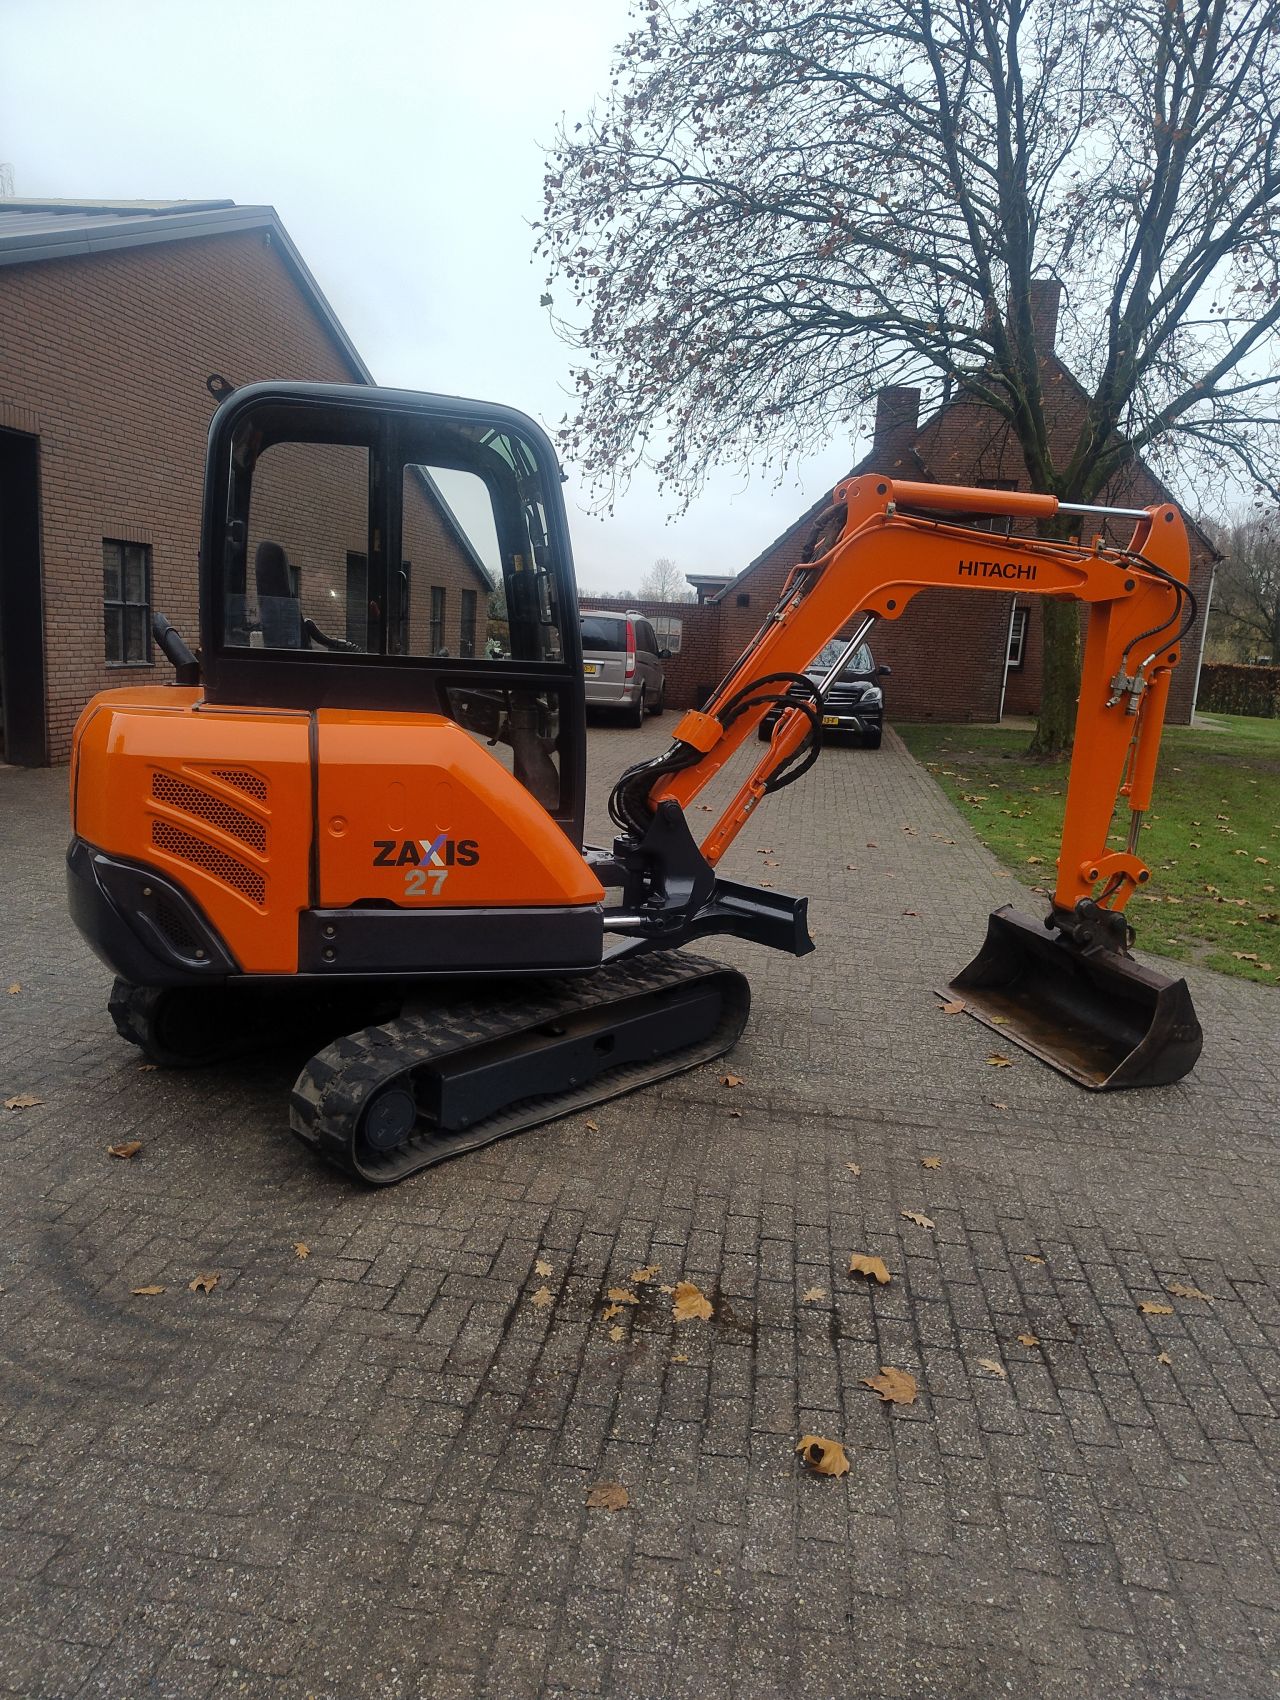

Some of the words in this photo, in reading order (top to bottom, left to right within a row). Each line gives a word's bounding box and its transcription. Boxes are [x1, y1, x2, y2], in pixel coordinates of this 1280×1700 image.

[958, 560, 1037, 580] HITACHI
[373, 834, 480, 867] ZAXIS
[404, 869, 449, 896] 27
